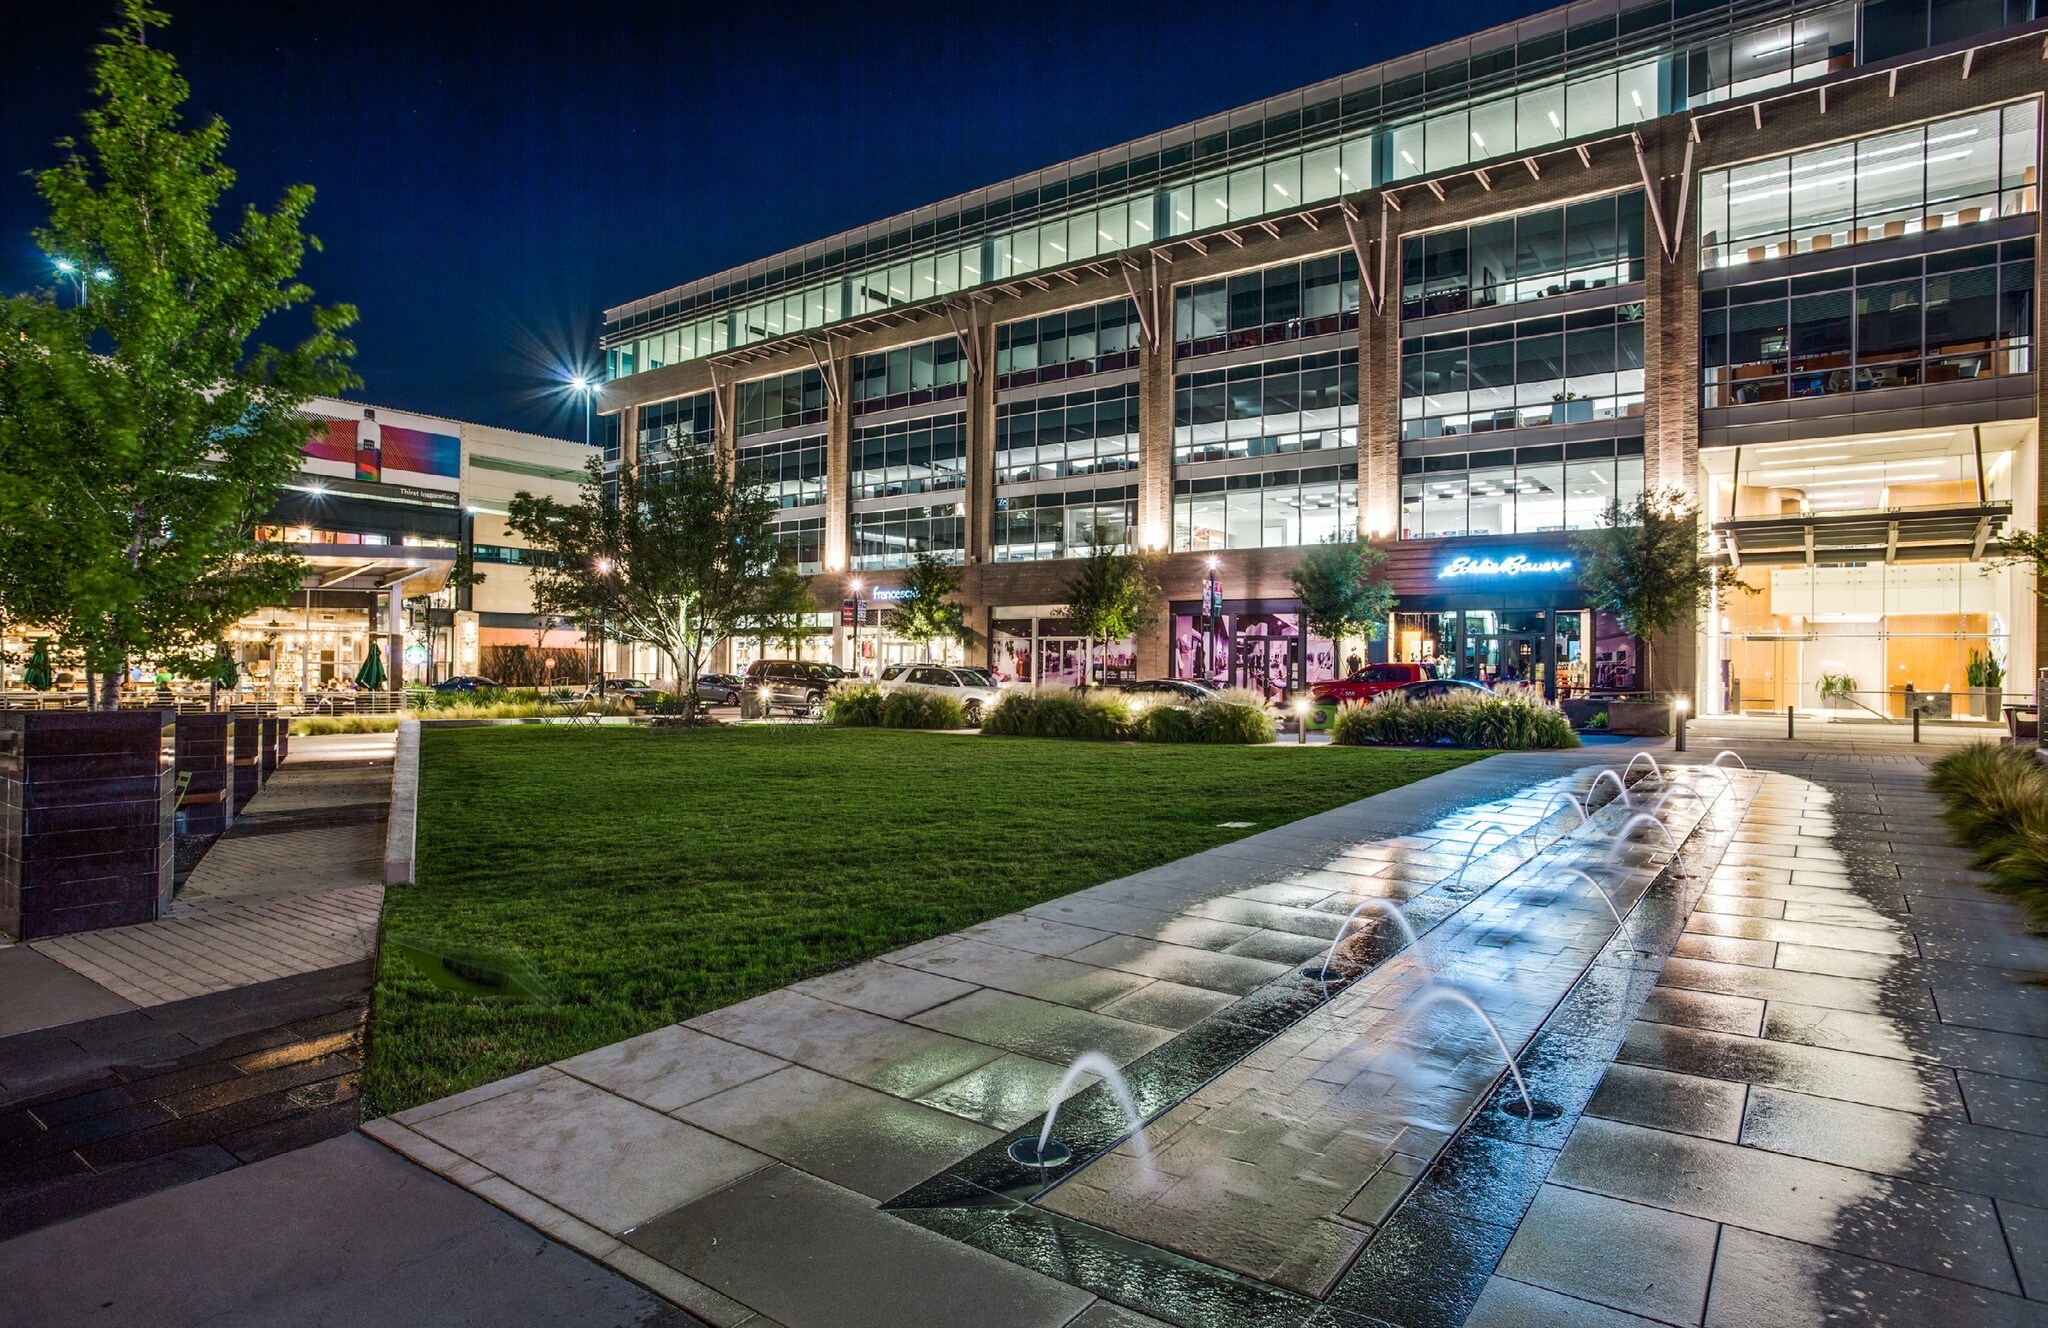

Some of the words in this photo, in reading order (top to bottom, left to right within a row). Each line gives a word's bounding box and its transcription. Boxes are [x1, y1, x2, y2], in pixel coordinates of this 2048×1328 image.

[400, 488, 419, 496] Thirst
[1438, 556, 1500, 578] Eddie
[1500, 555, 1571, 576] Bauer
